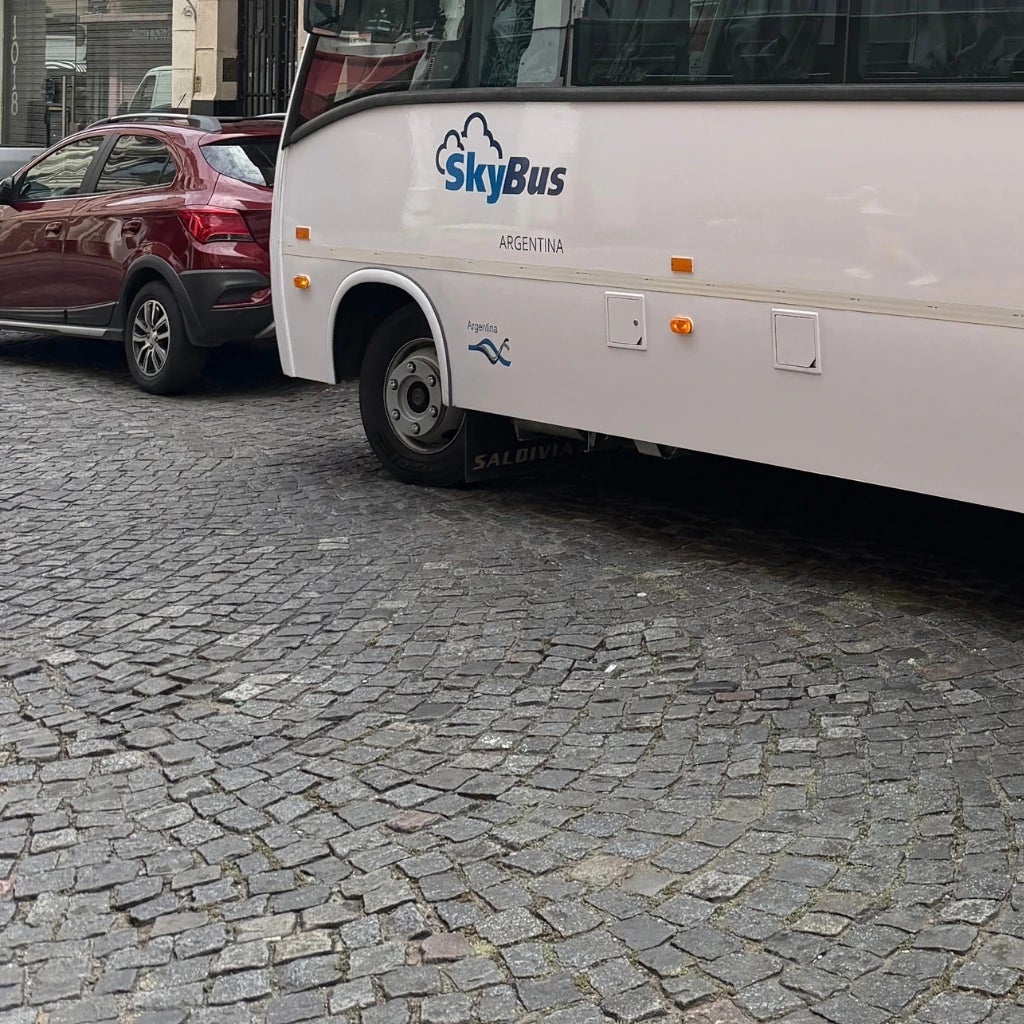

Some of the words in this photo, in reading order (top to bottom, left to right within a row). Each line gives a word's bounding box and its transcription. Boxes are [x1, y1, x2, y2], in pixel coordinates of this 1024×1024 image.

[10, 15, 19, 116] 1018
[445, 151, 567, 205] SkyBus
[499, 235, 564, 254] ARGENTINA
[467, 320, 498, 334] Argentina
[472, 441, 574, 471] SALDIVIA
